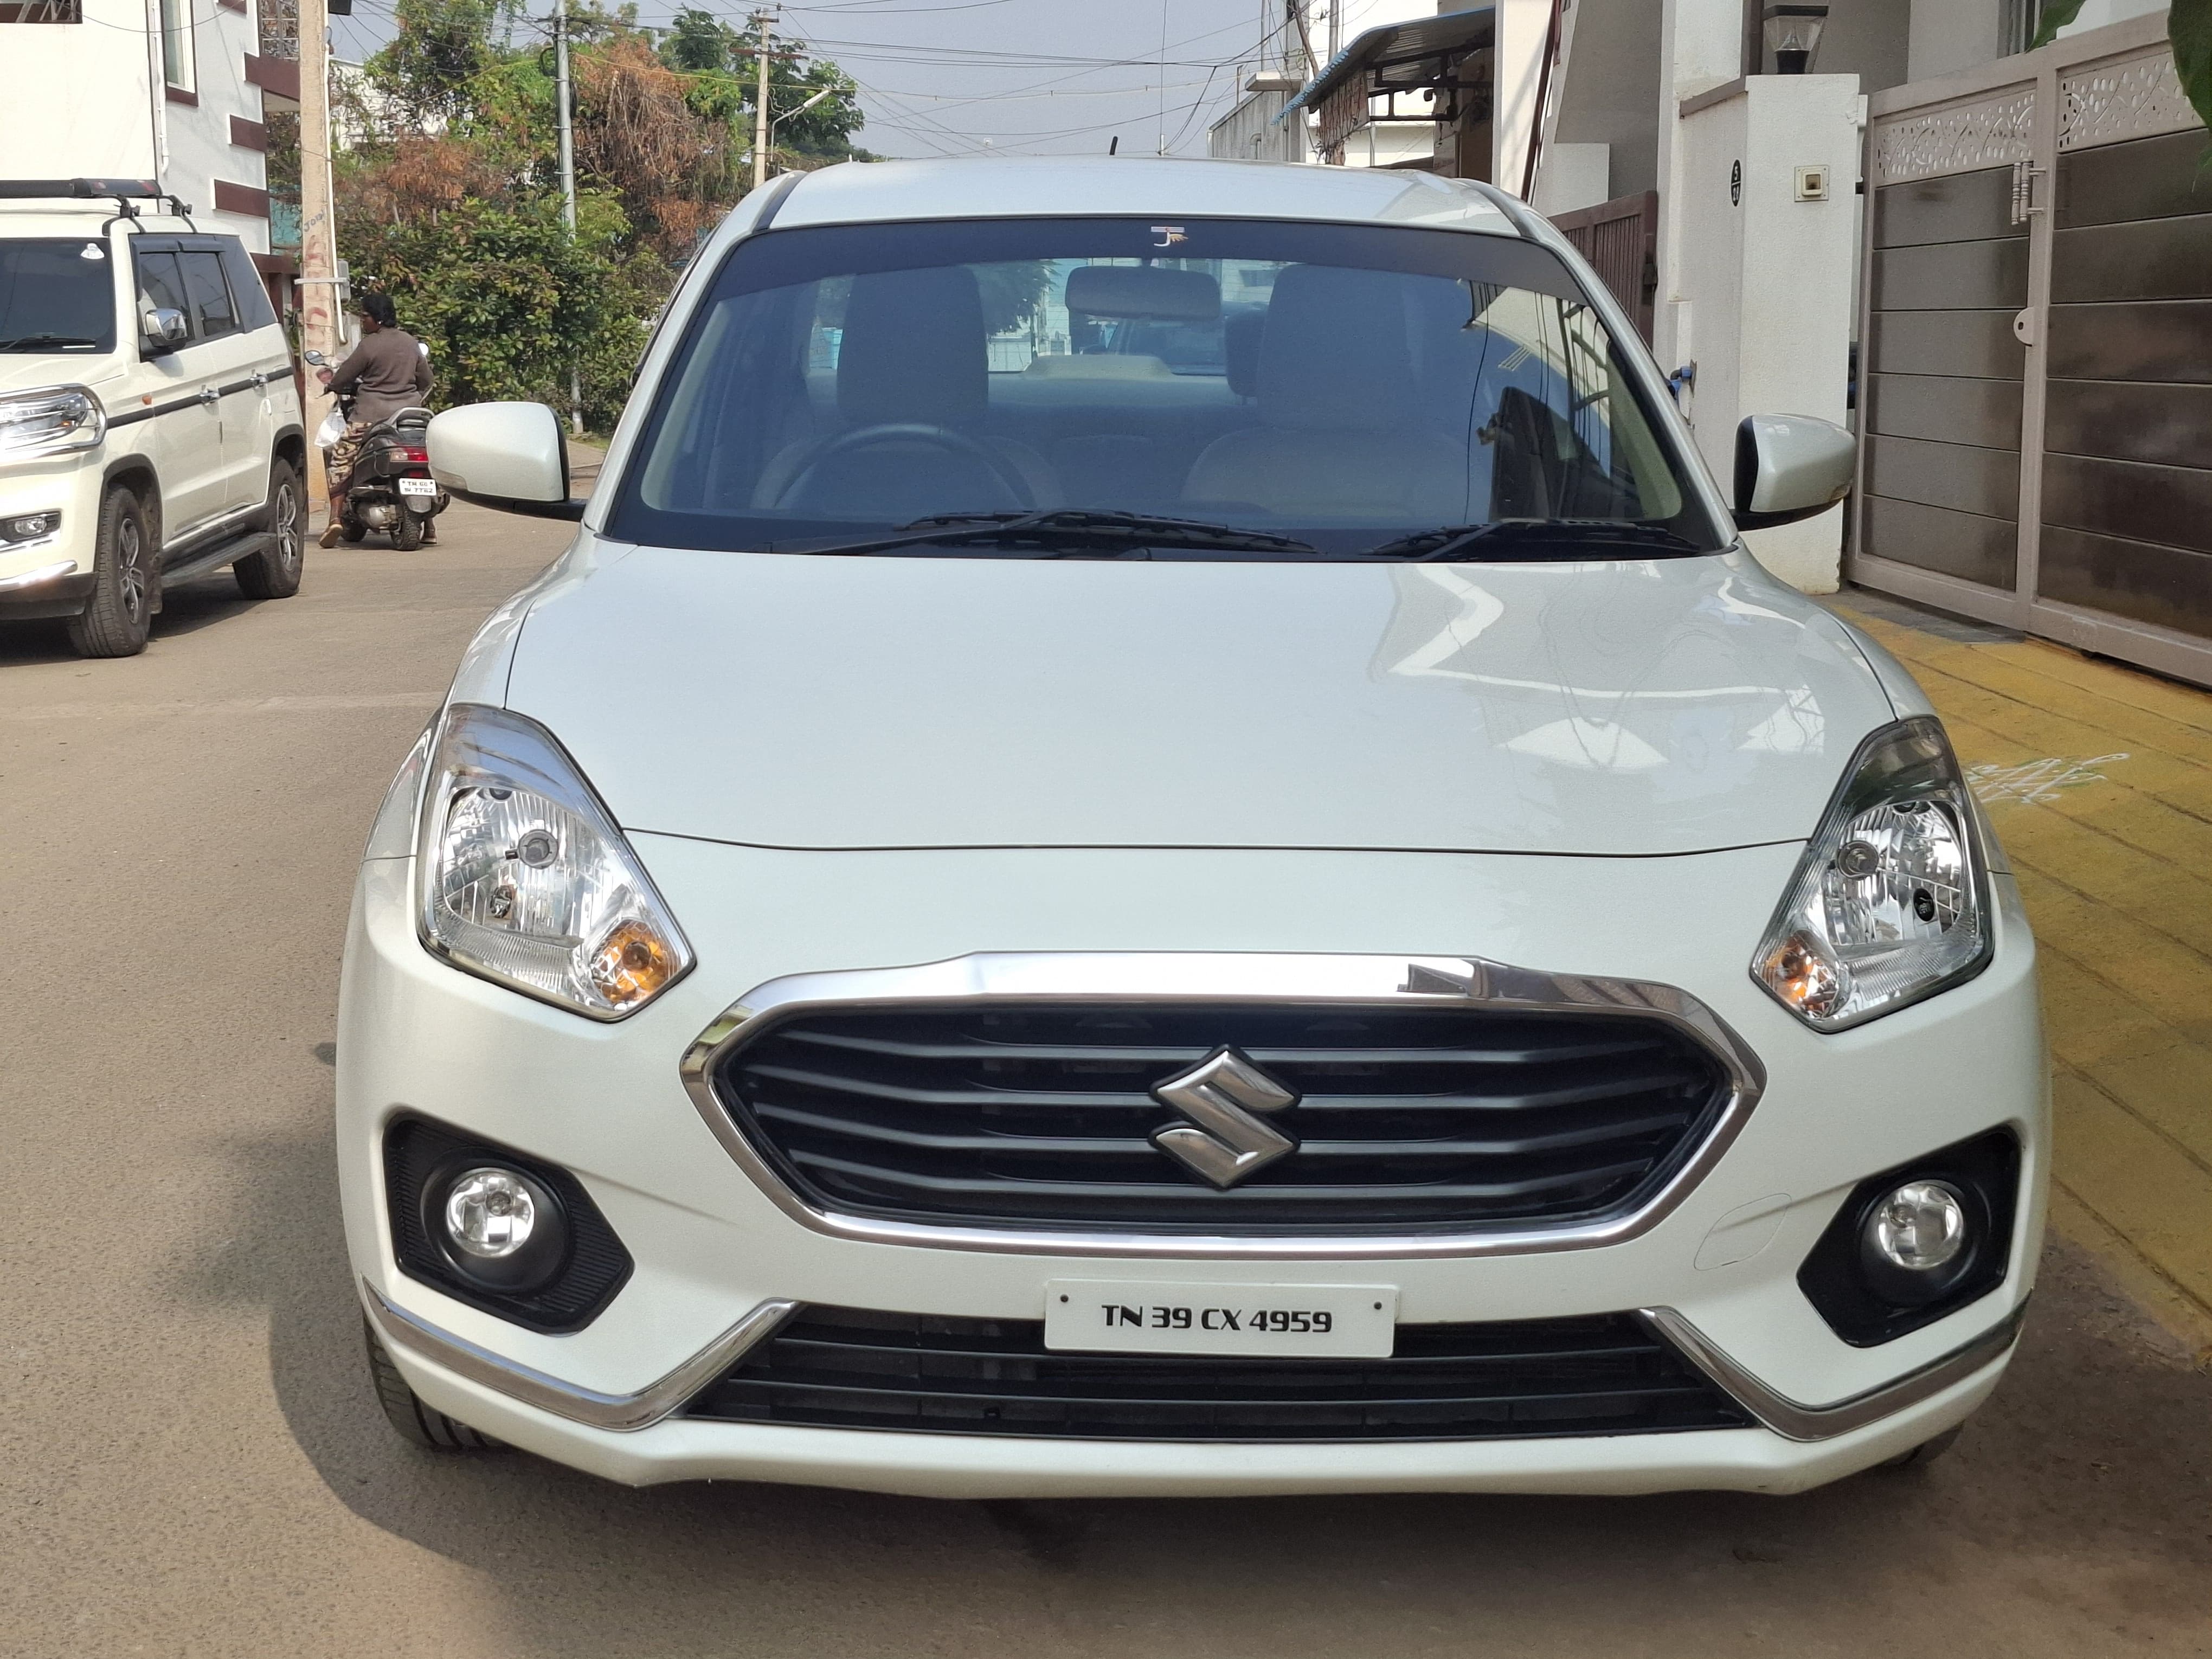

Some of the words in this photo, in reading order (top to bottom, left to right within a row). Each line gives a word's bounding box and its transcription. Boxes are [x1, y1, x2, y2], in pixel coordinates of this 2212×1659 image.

[1734, 166, 1738, 181] 5
[1102, 1305, 1143, 1327] TN
[1152, 1306, 1192, 1328] 39
[1201, 1309, 1242, 1330] CX
[1249, 1310, 1332, 1333] 4959
